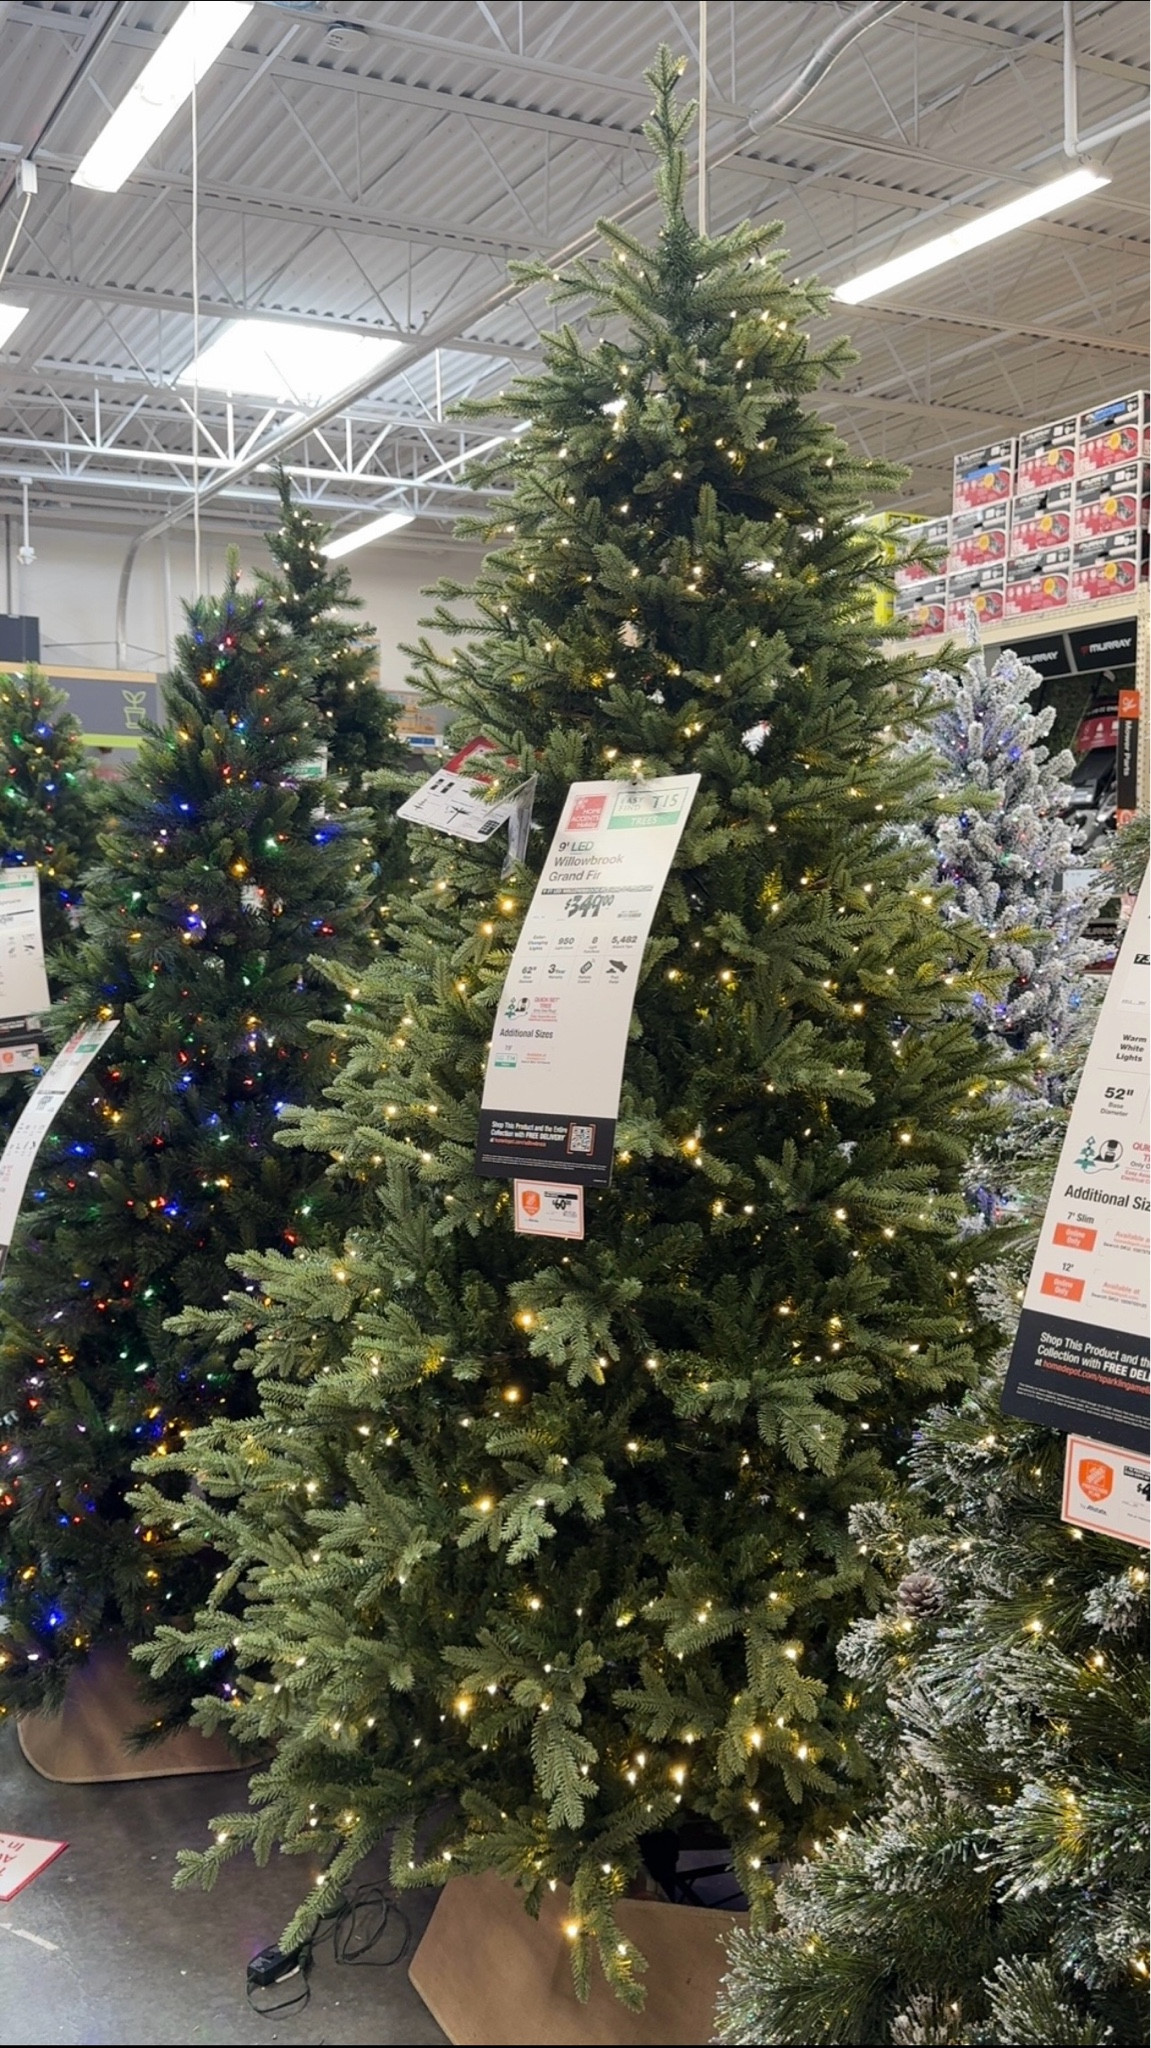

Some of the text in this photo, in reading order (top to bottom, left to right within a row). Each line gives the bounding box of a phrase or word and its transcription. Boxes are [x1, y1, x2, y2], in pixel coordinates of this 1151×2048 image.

[1089, 638, 1132, 654] MURRAY
[1123, 720, 1133, 776] Mower Parts
[652, 793, 679, 809] T15
[631, 816, 658, 826] TREES
[571, 841, 594, 852] LED
[554, 854, 624, 867] Willowbrook
[548, 869, 602, 882] Grand Fir
[500, 1028, 553, 1039] Additional Sizes
[1123, 1034, 1147, 1043] Warm
[1120, 1043, 1144, 1052] White
[1116, 1053, 1143, 1062] Lights
[1104, 1086, 1134, 1100] 52"
[1107, 1101, 1124, 1109] Base
[1100, 1108, 1128, 1118] Diameter
[491, 1121, 505, 1129] Shop
[515, 1123, 534, 1131] Product
[490, 1129, 514, 1137] Collection
[525, 1132, 539, 1140] FREE
[540, 1133, 566, 1141] DELIVERY
[1064, 1185, 1130, 1208] Additional
[1077, 1213, 1095, 1224] Slim
[1065, 1228, 1086, 1238] Online
[1115, 1231, 1144, 1242] Available
[1066, 1237, 1081, 1247] Only
[1062, 1262, 1074, 1272] 12'
[1053, 1278, 1073, 1288] Online
[1103, 1281, 1132, 1292] Available
[1054, 1286, 1069, 1296] Only
[1040, 1331, 1063, 1347] Shop
[1064, 1337, 1083, 1351] This
[1084, 1343, 1119, 1360] Product
[1120, 1353, 1139, 1365] and
[1034, 1358, 1042, 1366] at
[1037, 1344, 1080, 1364] Collection
[1081, 1356, 1101, 1369] with
[1102, 1361, 1128, 1376] FREE
